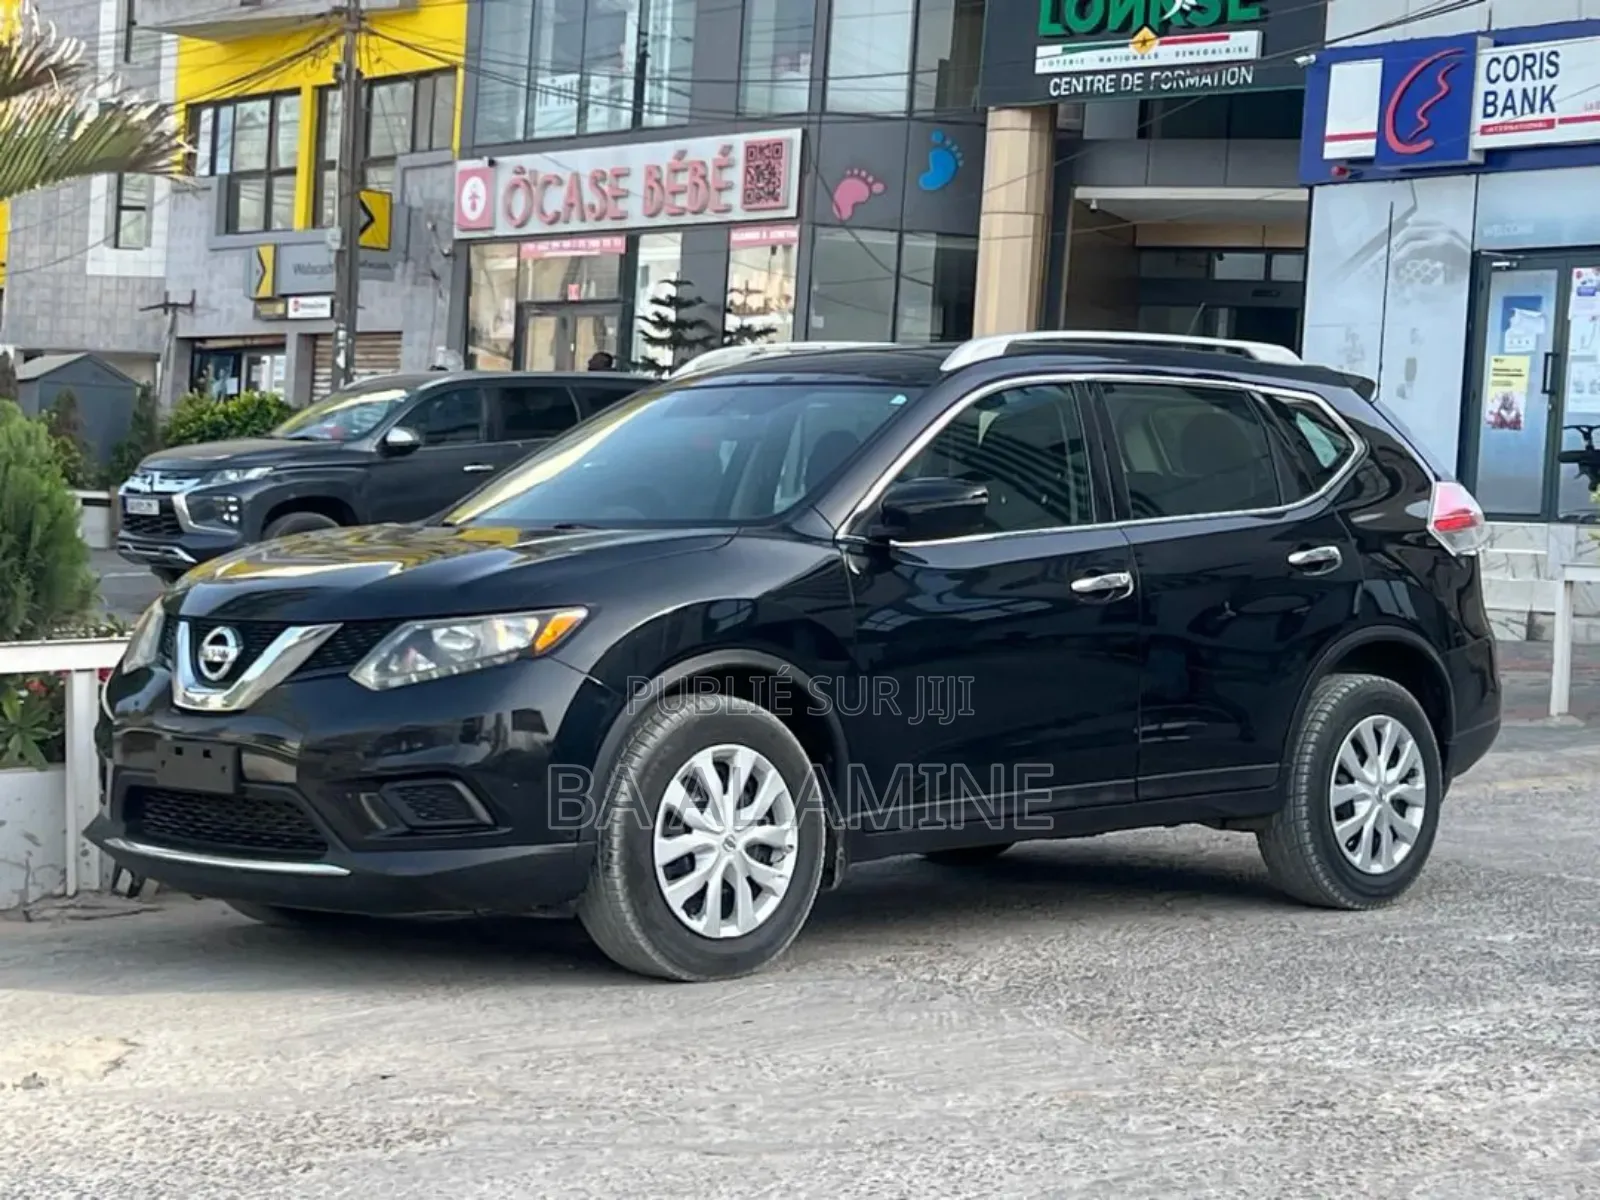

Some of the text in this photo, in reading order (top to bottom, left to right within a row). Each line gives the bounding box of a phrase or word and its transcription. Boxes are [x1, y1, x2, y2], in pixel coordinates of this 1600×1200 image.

[1049, 66, 1254, 97] CENTRE DE FORMATION
[1486, 50, 1560, 84] CORIS
[1482, 84, 1558, 119] BANK
[643, 144, 735, 218] BÉBÉ
